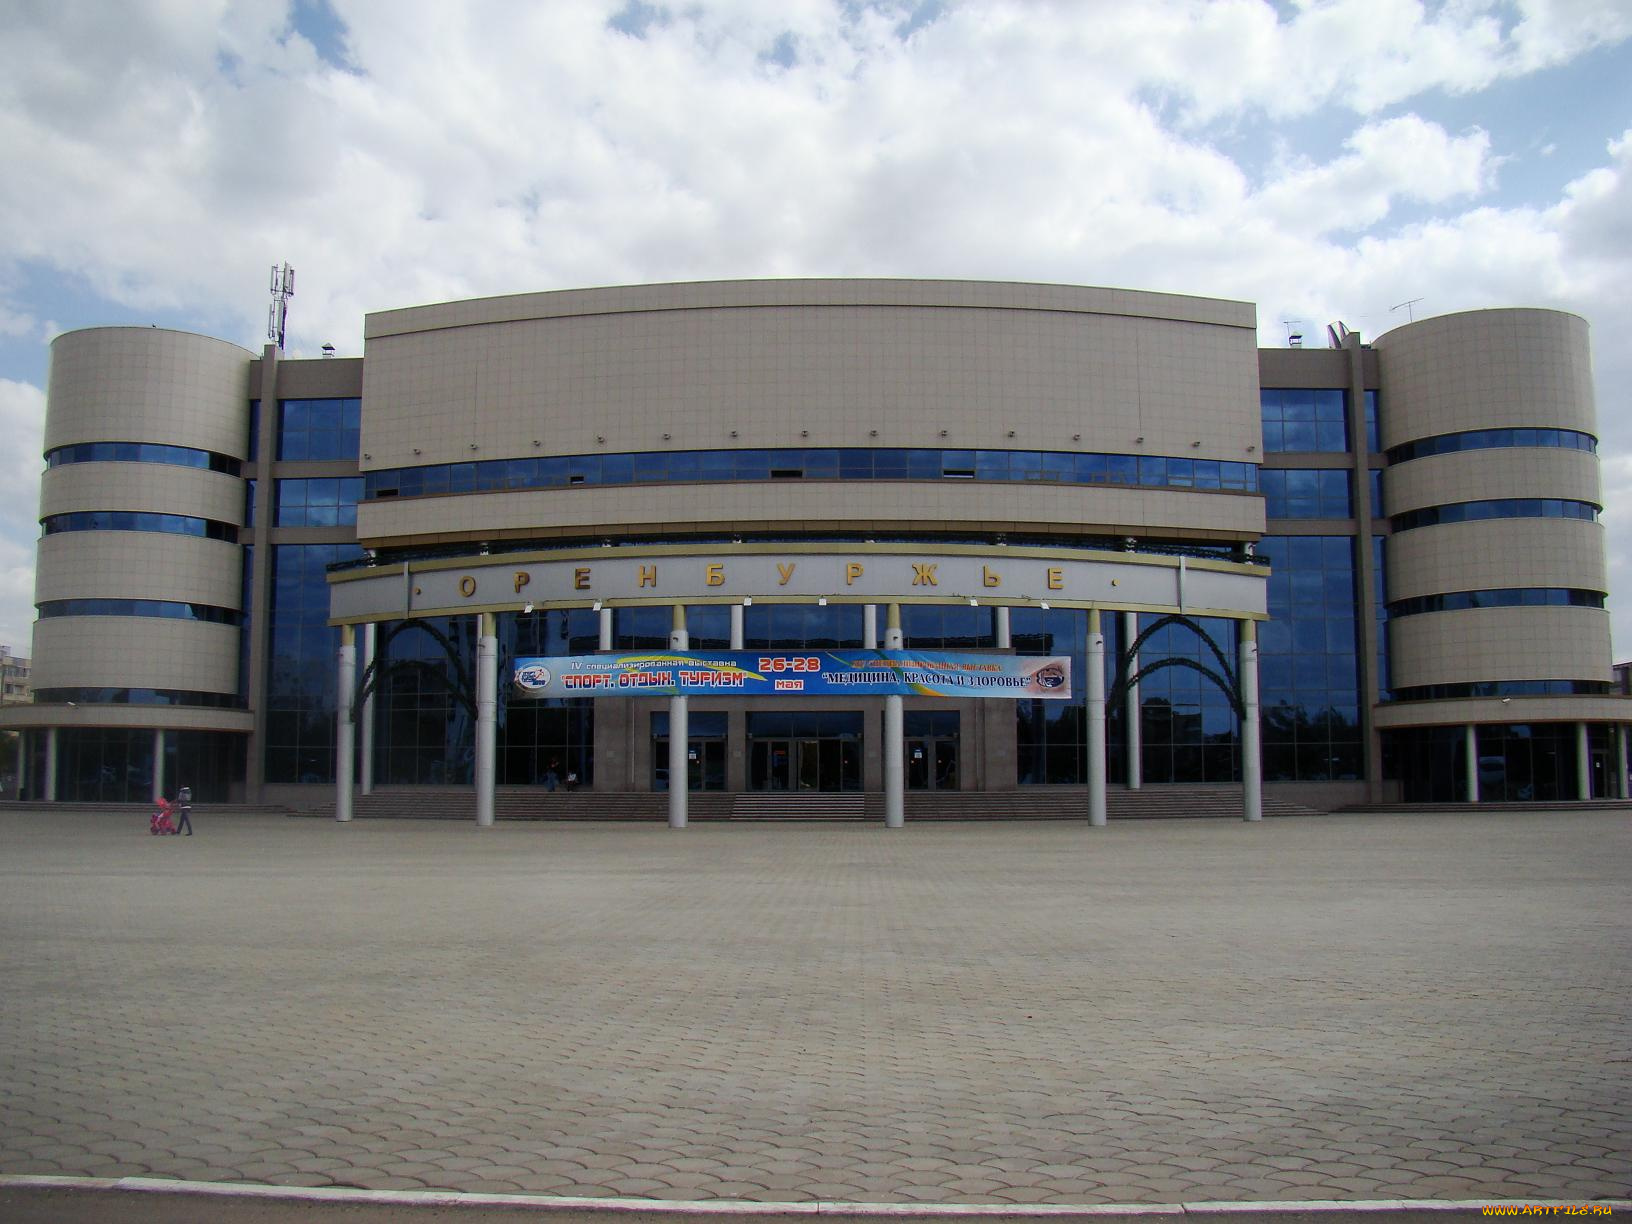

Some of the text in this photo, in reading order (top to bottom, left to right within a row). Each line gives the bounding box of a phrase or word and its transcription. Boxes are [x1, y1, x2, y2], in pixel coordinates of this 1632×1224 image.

[459, 563, 1065, 597] ОРЕНБУРЖЬЕ
[571, 660, 737, 671] IV специализированная выставка
[758, 657, 821, 673] 26-28
[776, 680, 804, 690] мая
[904, 672, 954, 686] КРАСОТА
[956, 675, 966, 686] И
